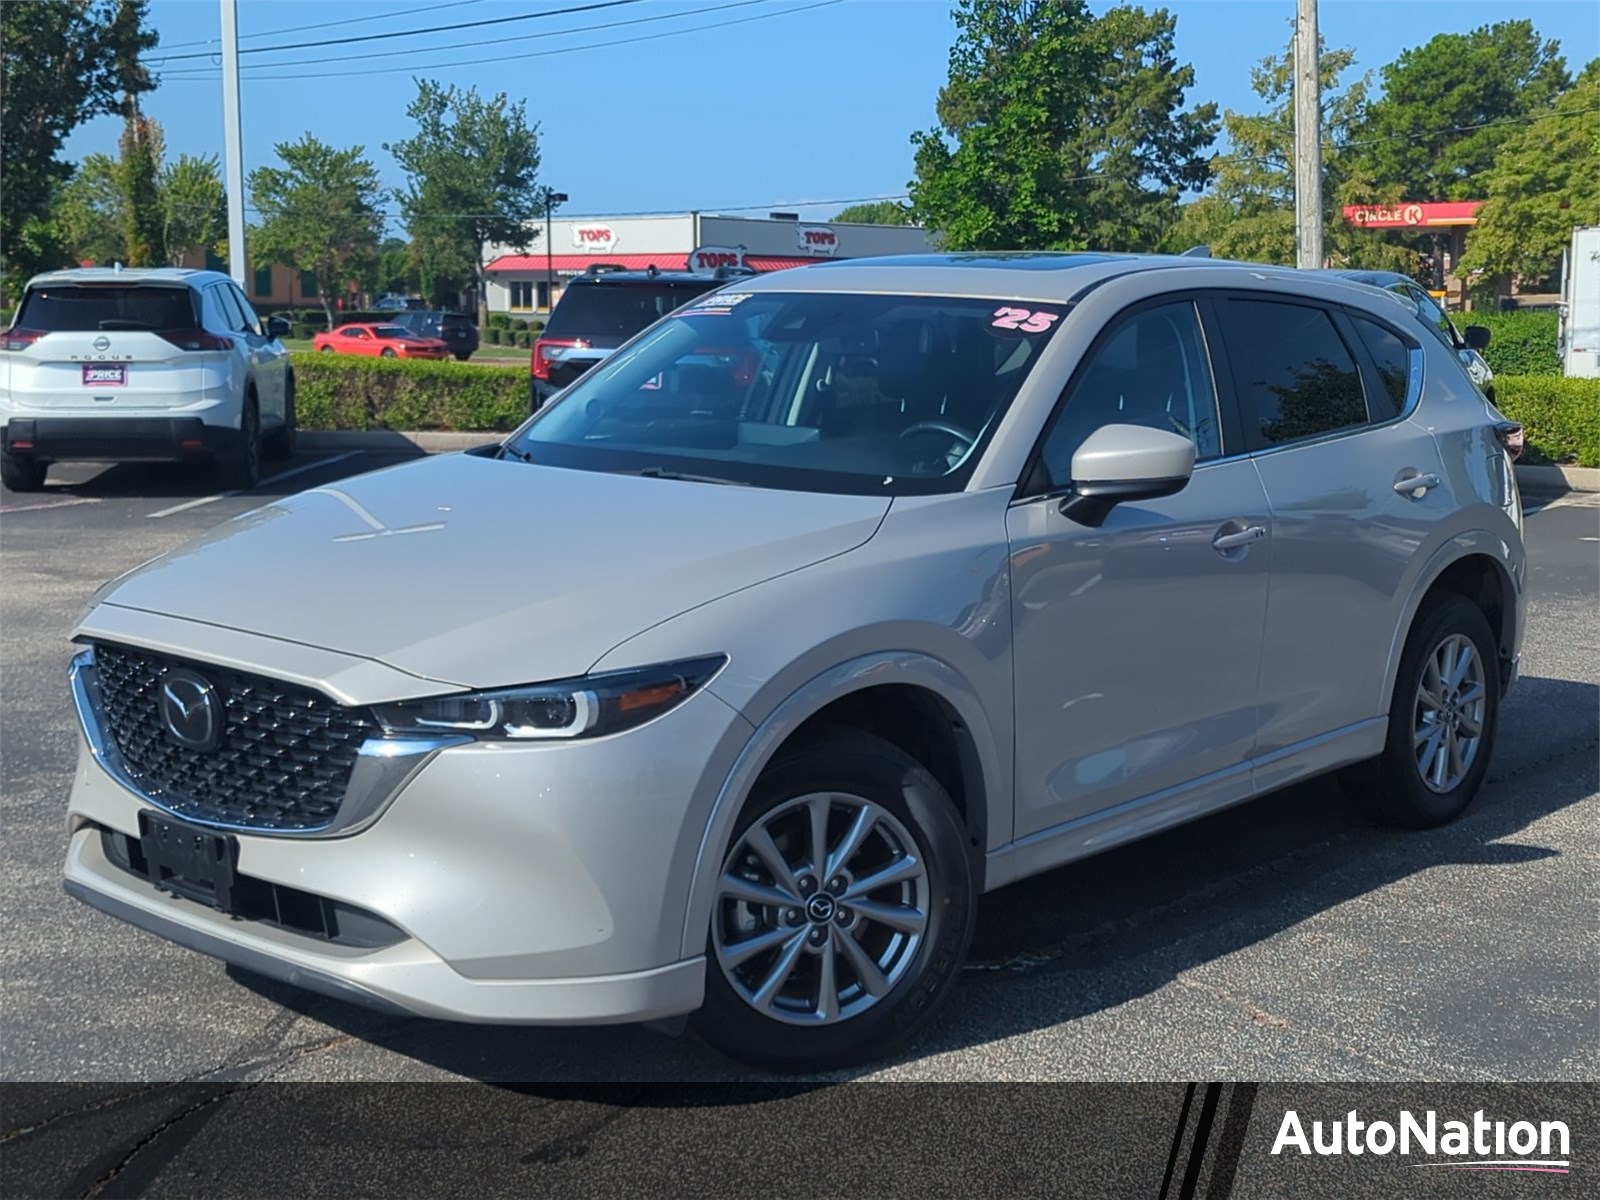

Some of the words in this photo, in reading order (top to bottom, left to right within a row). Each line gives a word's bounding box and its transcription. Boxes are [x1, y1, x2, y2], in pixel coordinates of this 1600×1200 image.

[1406, 207, 1421, 224] K
[578, 228, 612, 242] TOPS
[804, 230, 836, 245] TOPS
[696, 252, 739, 269] TOPS
